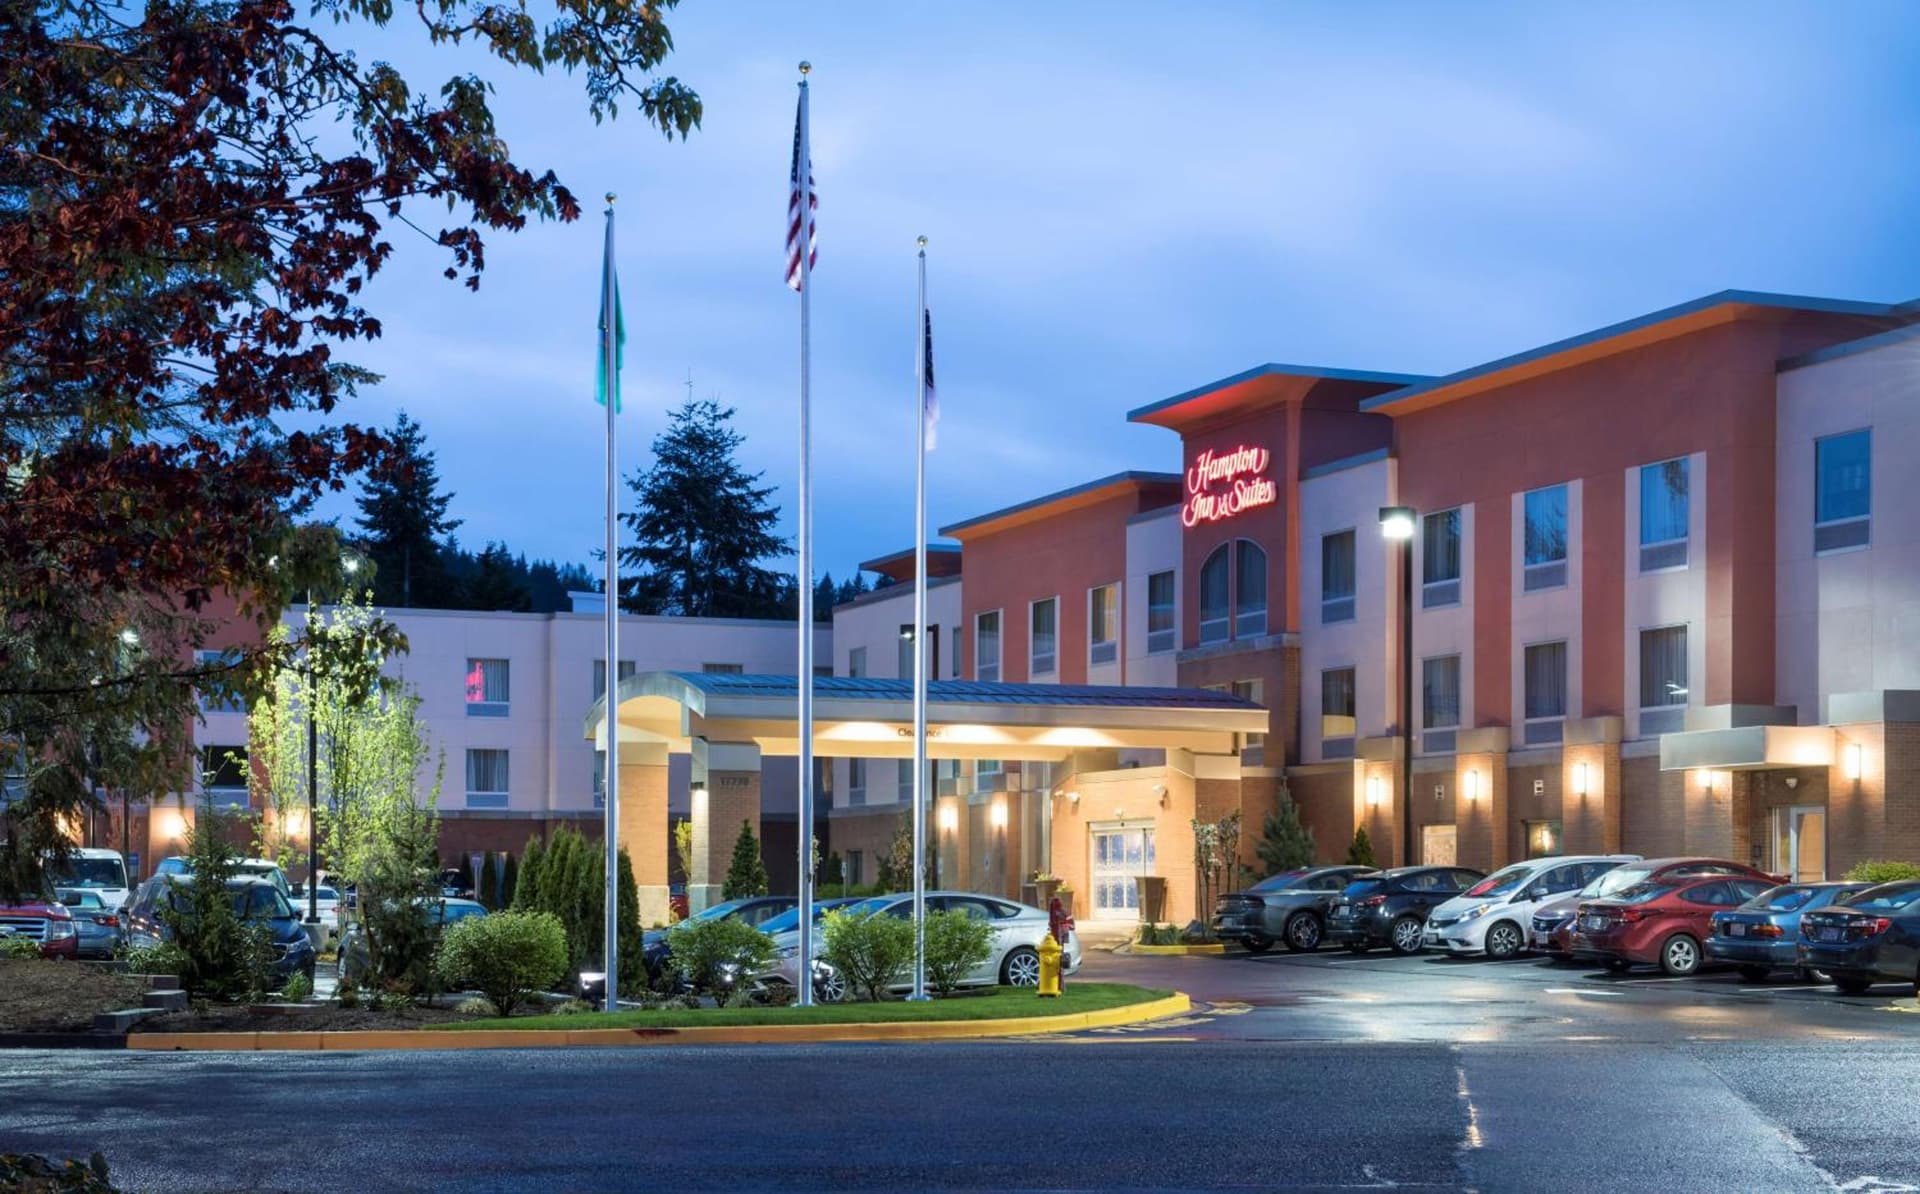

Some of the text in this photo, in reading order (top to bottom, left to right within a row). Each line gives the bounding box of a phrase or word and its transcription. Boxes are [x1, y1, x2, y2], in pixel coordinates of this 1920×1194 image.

[1188, 445, 1268, 493] Hampton
[1182, 492, 1221, 527] Inn
[1229, 477, 1276, 512] Suites
